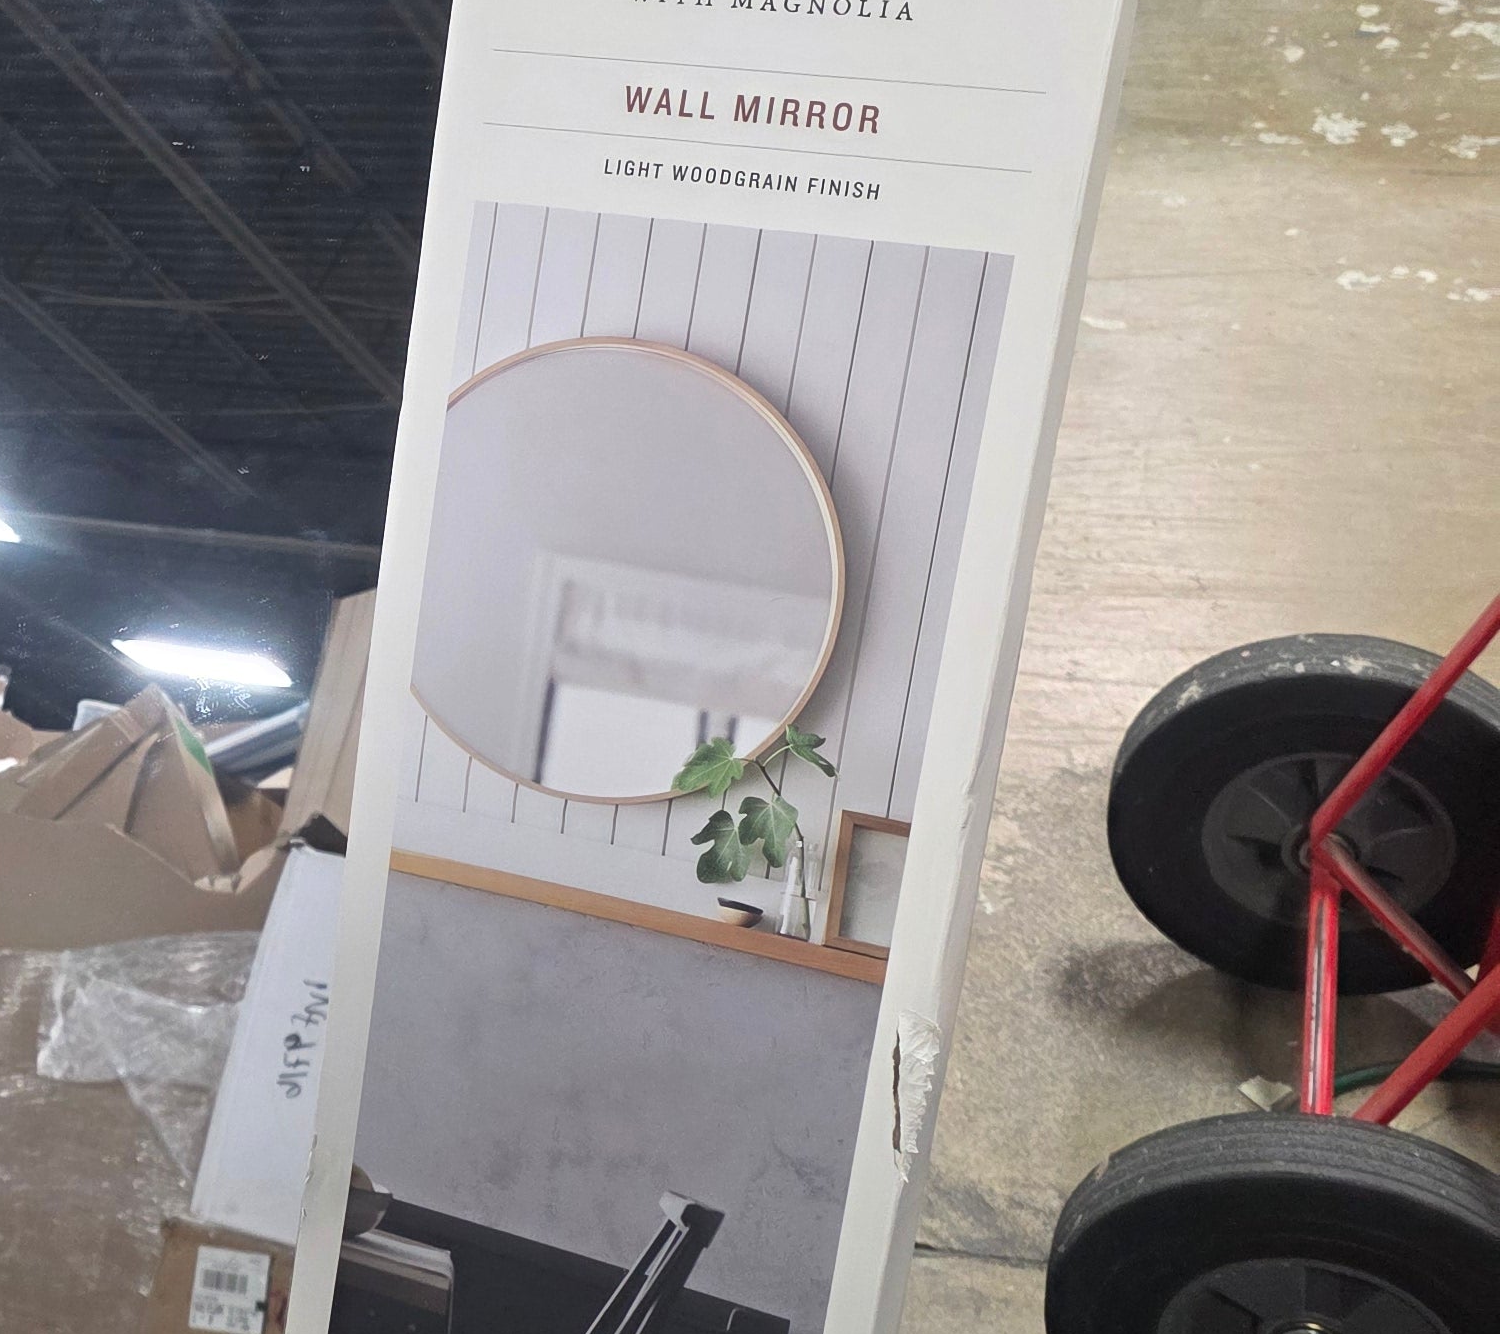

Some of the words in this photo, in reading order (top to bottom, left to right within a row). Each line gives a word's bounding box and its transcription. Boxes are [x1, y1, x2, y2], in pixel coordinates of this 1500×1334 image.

[624, 84, 716, 121] WALL
[732, 93, 881, 135] MIRROR
[603, 158, 664, 180] LIGHT
[671, 163, 799, 193] WOODGRAIN
[806, 176, 881, 201] FINISH
